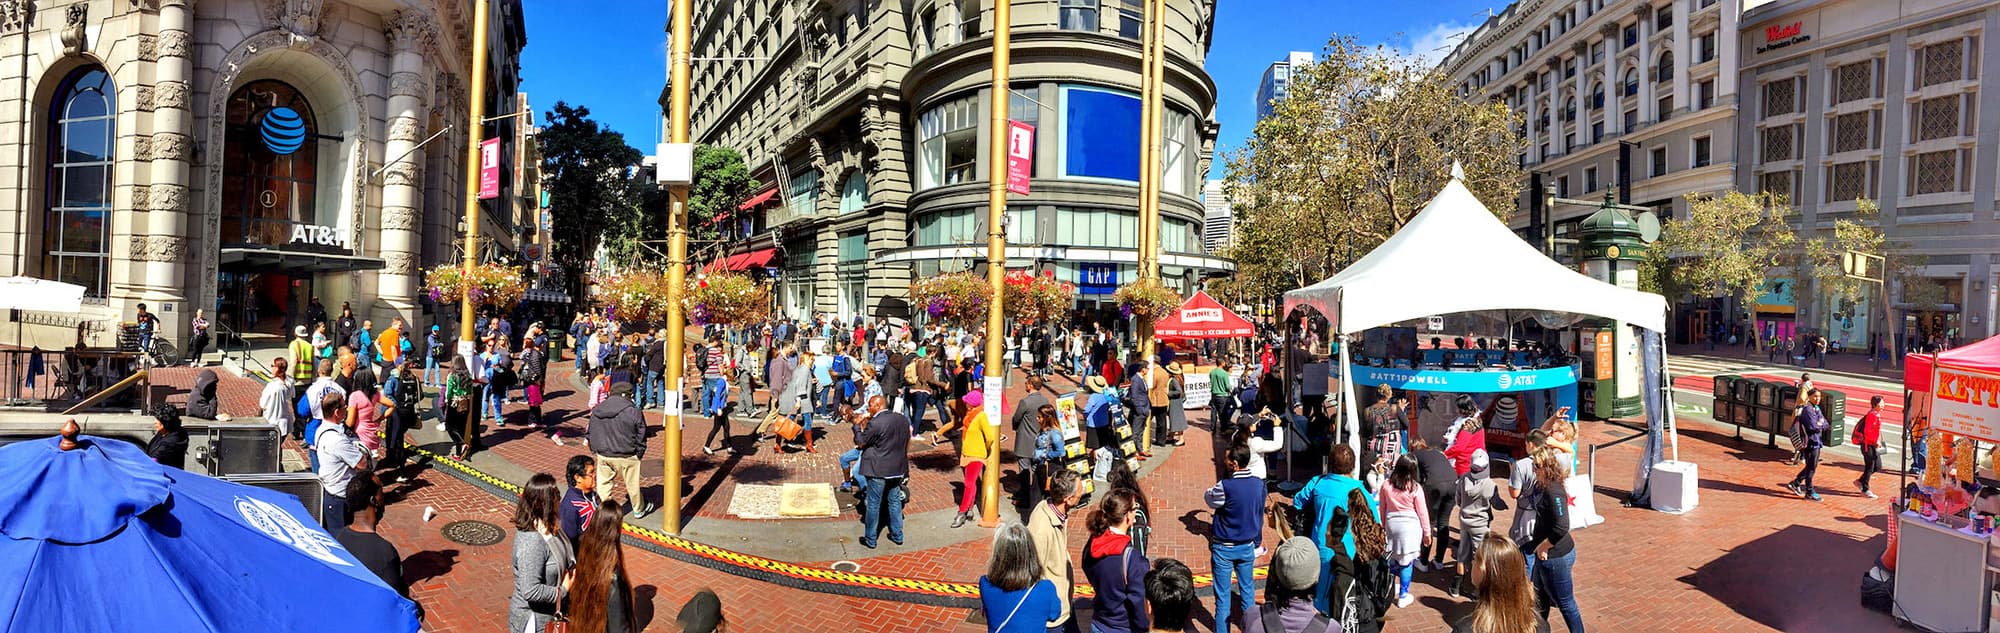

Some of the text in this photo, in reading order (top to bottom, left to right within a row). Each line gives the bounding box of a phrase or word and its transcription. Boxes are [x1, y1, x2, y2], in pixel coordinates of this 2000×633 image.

[1766, 21, 1802, 42] Westfield
[288, 223, 346, 247] AT&T
[1088, 267, 1110, 284] GAP
[1514, 374, 1537, 386] AT&T
